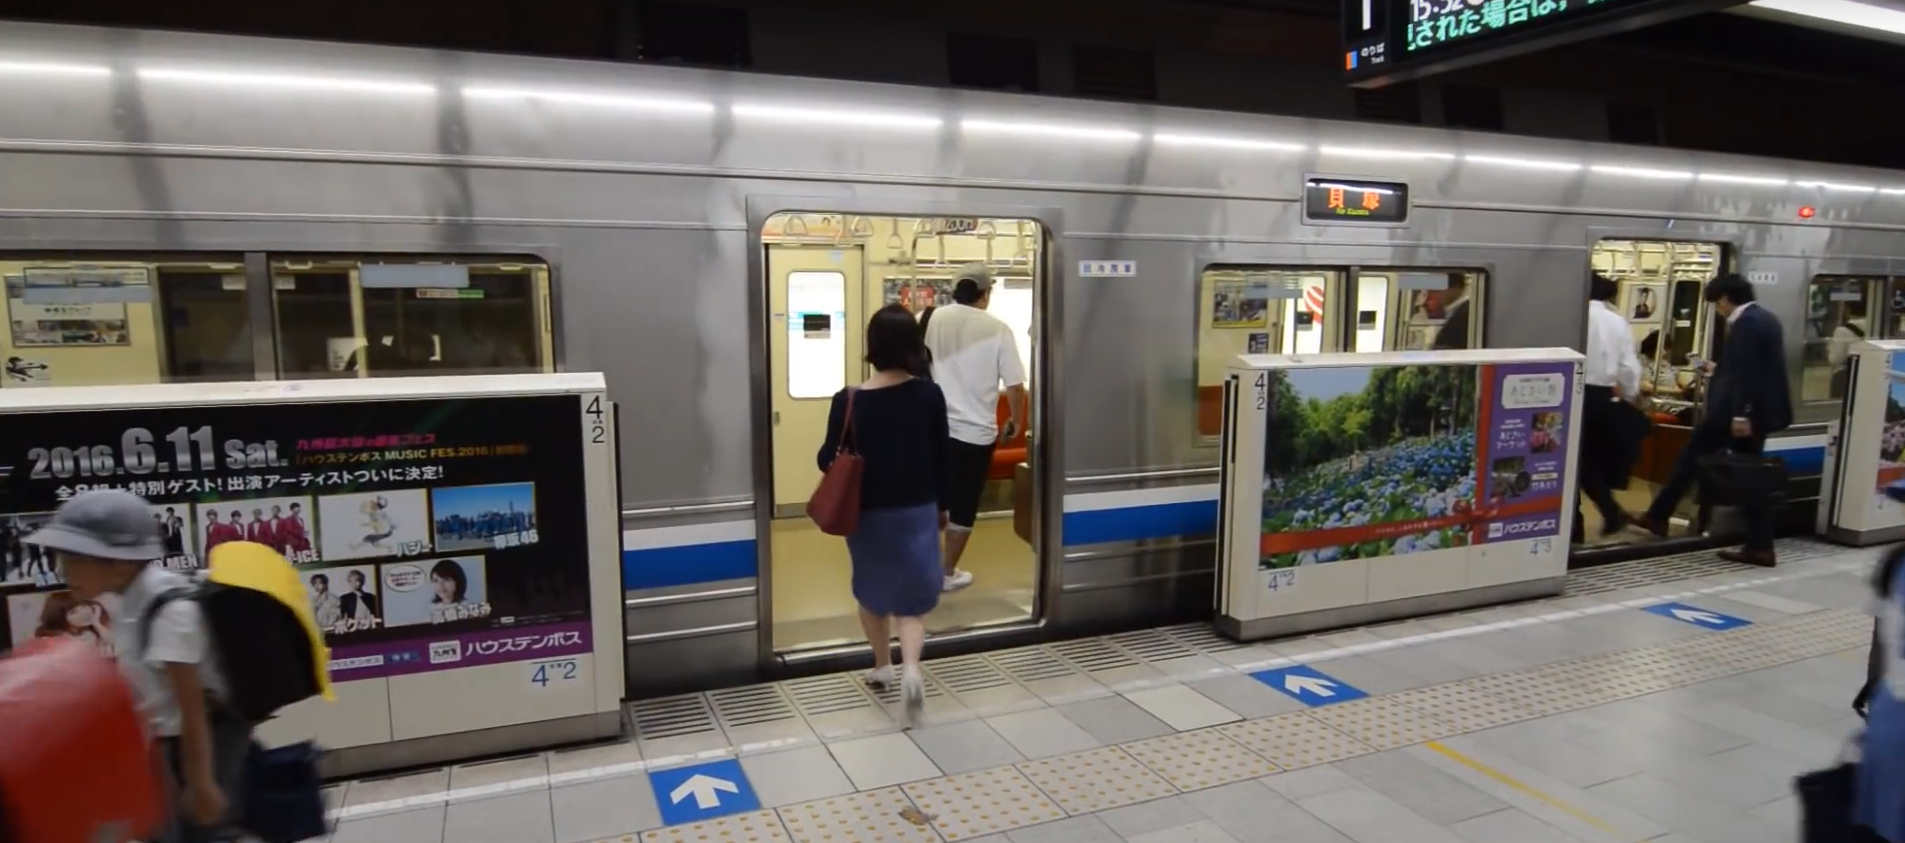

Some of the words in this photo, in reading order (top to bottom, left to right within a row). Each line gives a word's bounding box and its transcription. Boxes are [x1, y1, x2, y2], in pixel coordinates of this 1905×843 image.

[1255, 373, 1266, 391] 4
[586, 395, 604, 420] 4
[1256, 396, 1265, 410] 2
[592, 425, 605, 444] 2
[27, 425, 216, 480] 2016.6.11
[224, 438, 289, 469] Sat.
[385, 447, 427, 460] MUSIC
[228, 465, 444, 492] 出演アーティストついに決定!
[1268, 573, 1279, 592] 4
[466, 631, 582, 656] ハウステンボス
[531, 664, 549, 686] 4
[563, 661, 576, 679] 2
